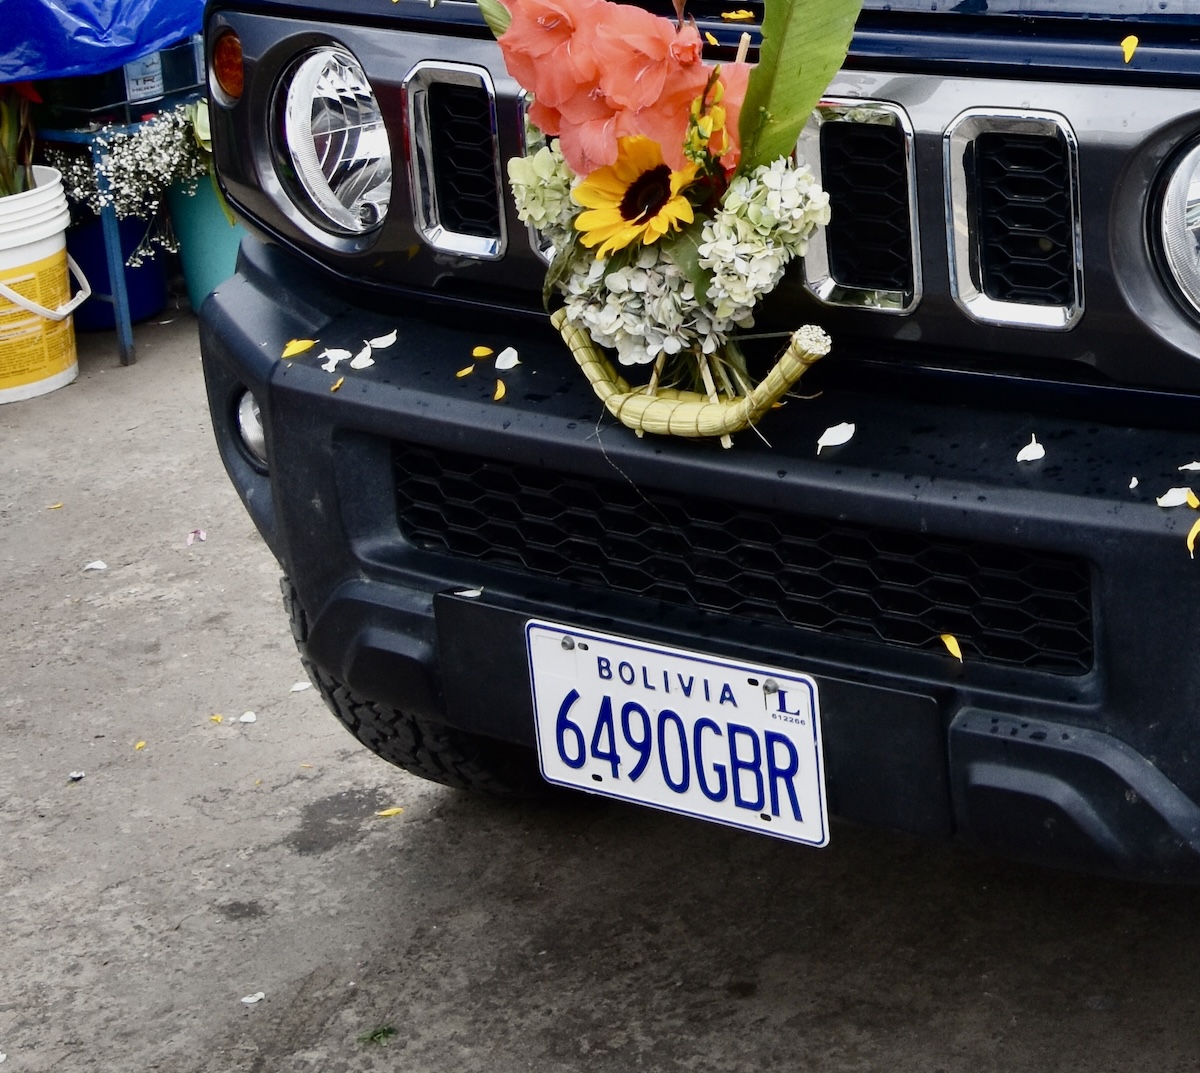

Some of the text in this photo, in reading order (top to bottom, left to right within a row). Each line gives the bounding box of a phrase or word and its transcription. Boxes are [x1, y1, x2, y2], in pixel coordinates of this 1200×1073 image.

[597, 656, 738, 709] BOLIVIA
[776, 689, 801, 716] L
[555, 688, 804, 823] 6490GBR
